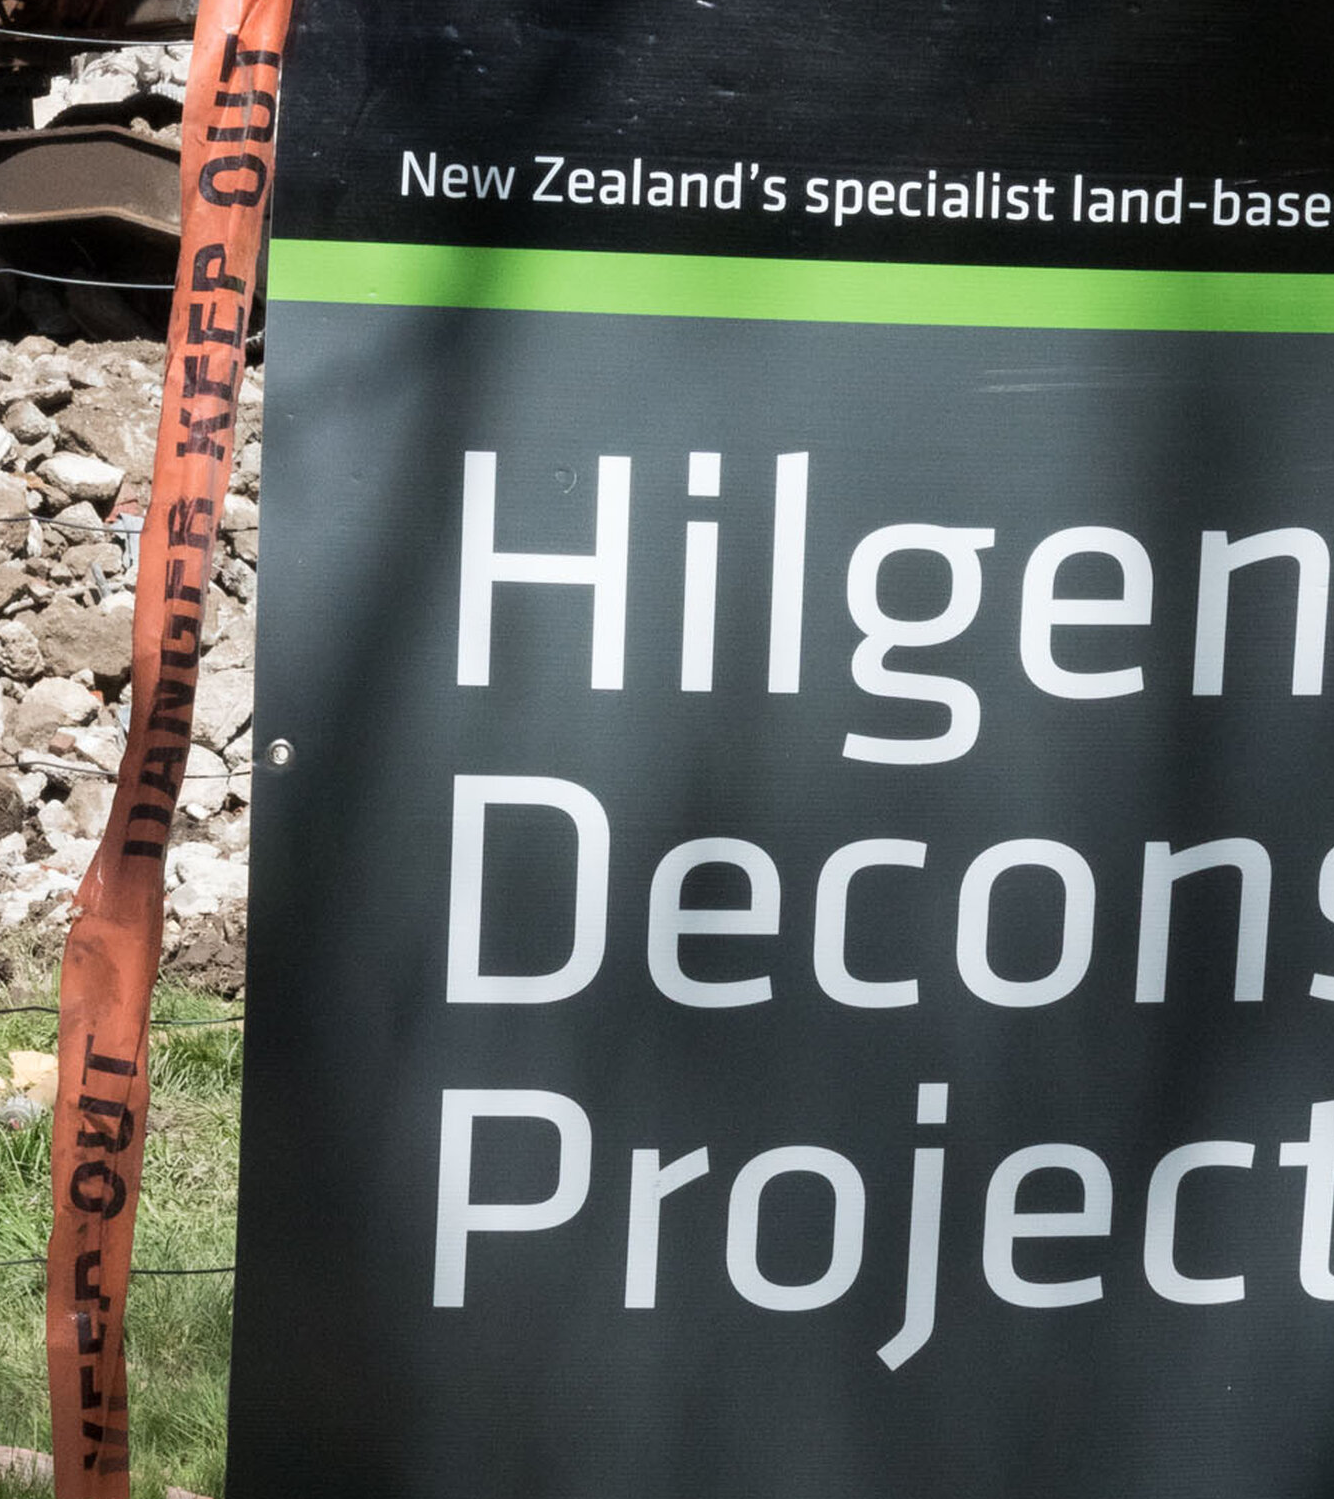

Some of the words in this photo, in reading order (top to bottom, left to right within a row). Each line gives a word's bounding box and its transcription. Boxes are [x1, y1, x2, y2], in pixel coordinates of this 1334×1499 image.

[198, 33, 280, 208] OUT
[401, 150, 516, 200] New
[805, 169, 1056, 227] specialist
[175, 243, 246, 458] KEEP
[69, 1033, 138, 1220] OUT
